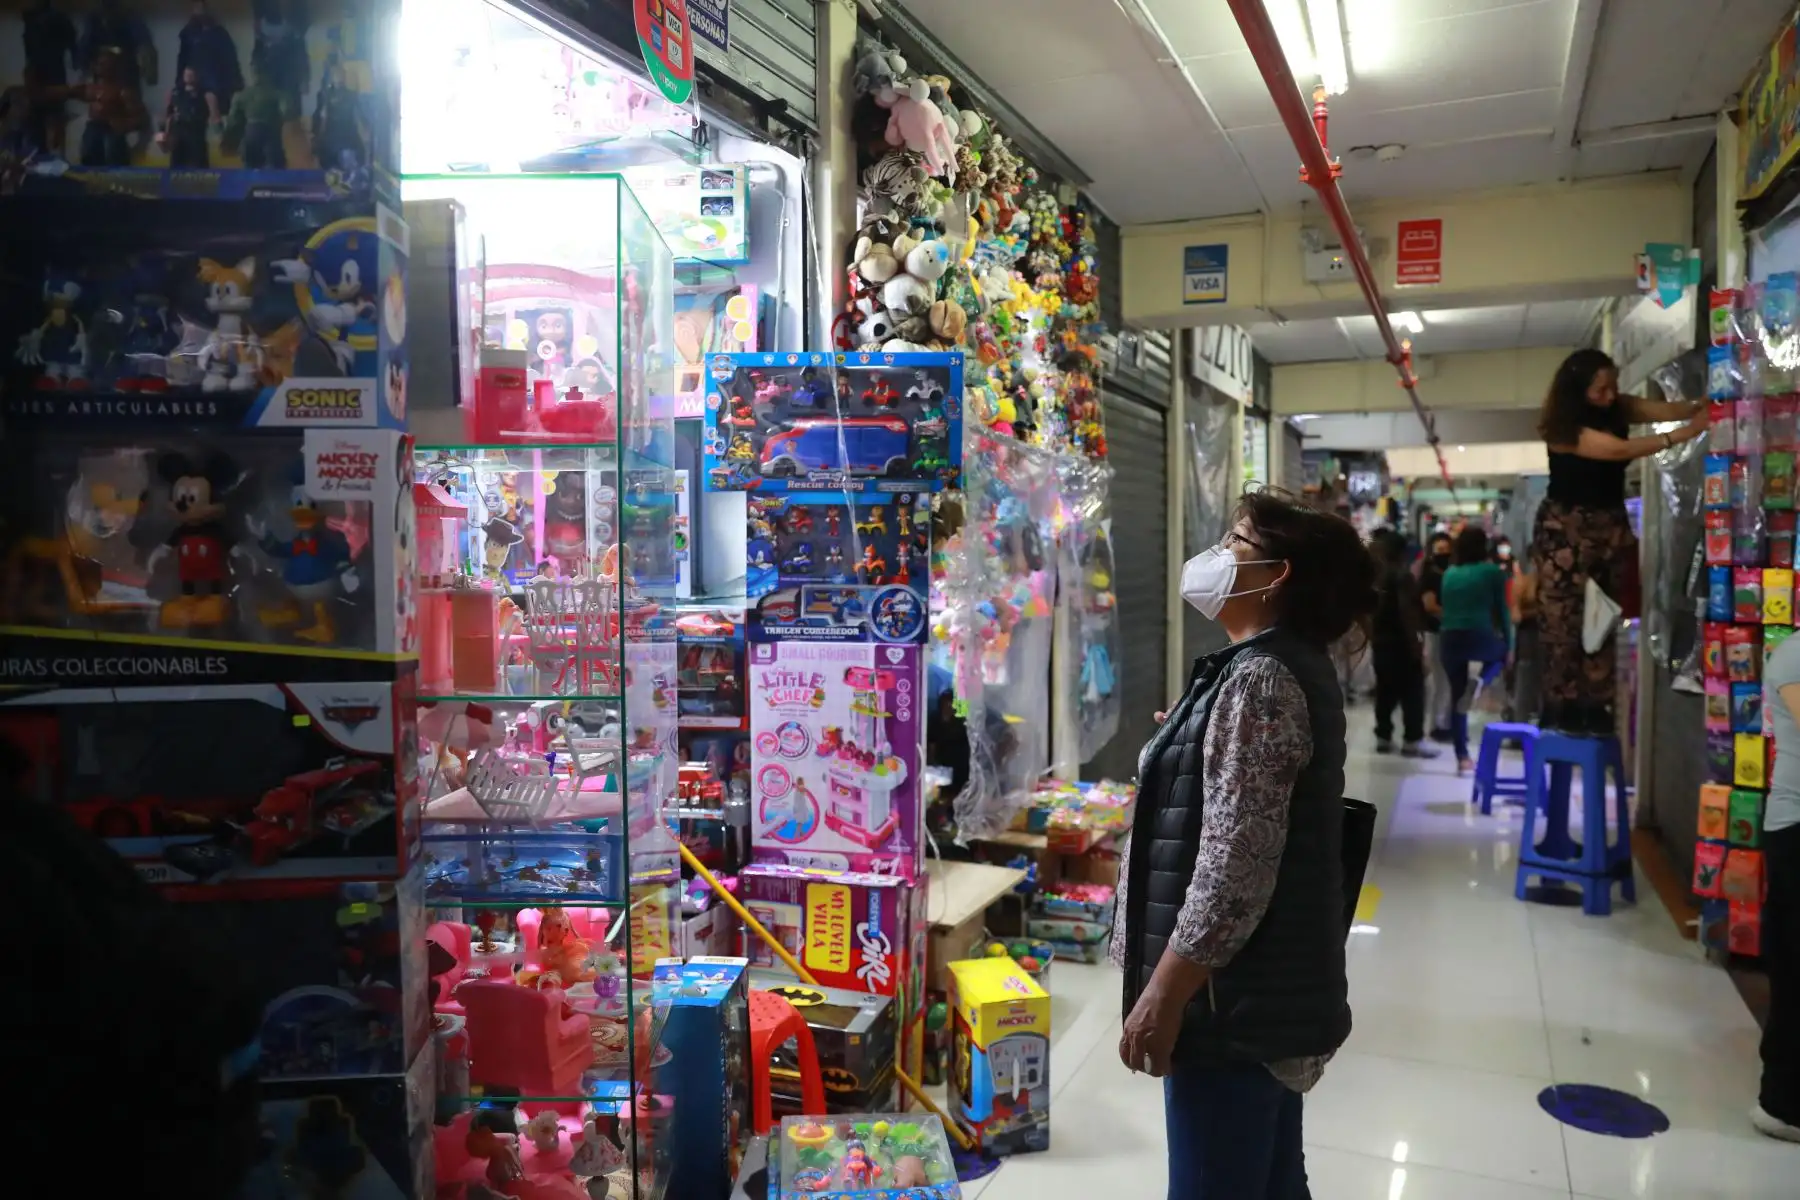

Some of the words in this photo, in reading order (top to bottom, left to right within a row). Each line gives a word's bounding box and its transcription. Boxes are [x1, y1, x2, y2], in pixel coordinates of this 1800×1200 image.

[668, 15, 681, 34] VISA
[687, 4, 726, 45] PERSONAS
[1192, 276, 1220, 291] VISA
[67, 400, 217, 416] ARTICULABLES
[286, 388, 361, 409] SONIC
[317, 453, 378, 466] MICKEY
[317, 466, 376, 479] MOUSE
[787, 479, 824, 489] Rescue
[52, 656, 229, 676] COLECCIONABLES
[831, 889, 844, 909] MY
[813, 903, 827, 948] VILLA
[830, 915, 844, 967] LOVELY
